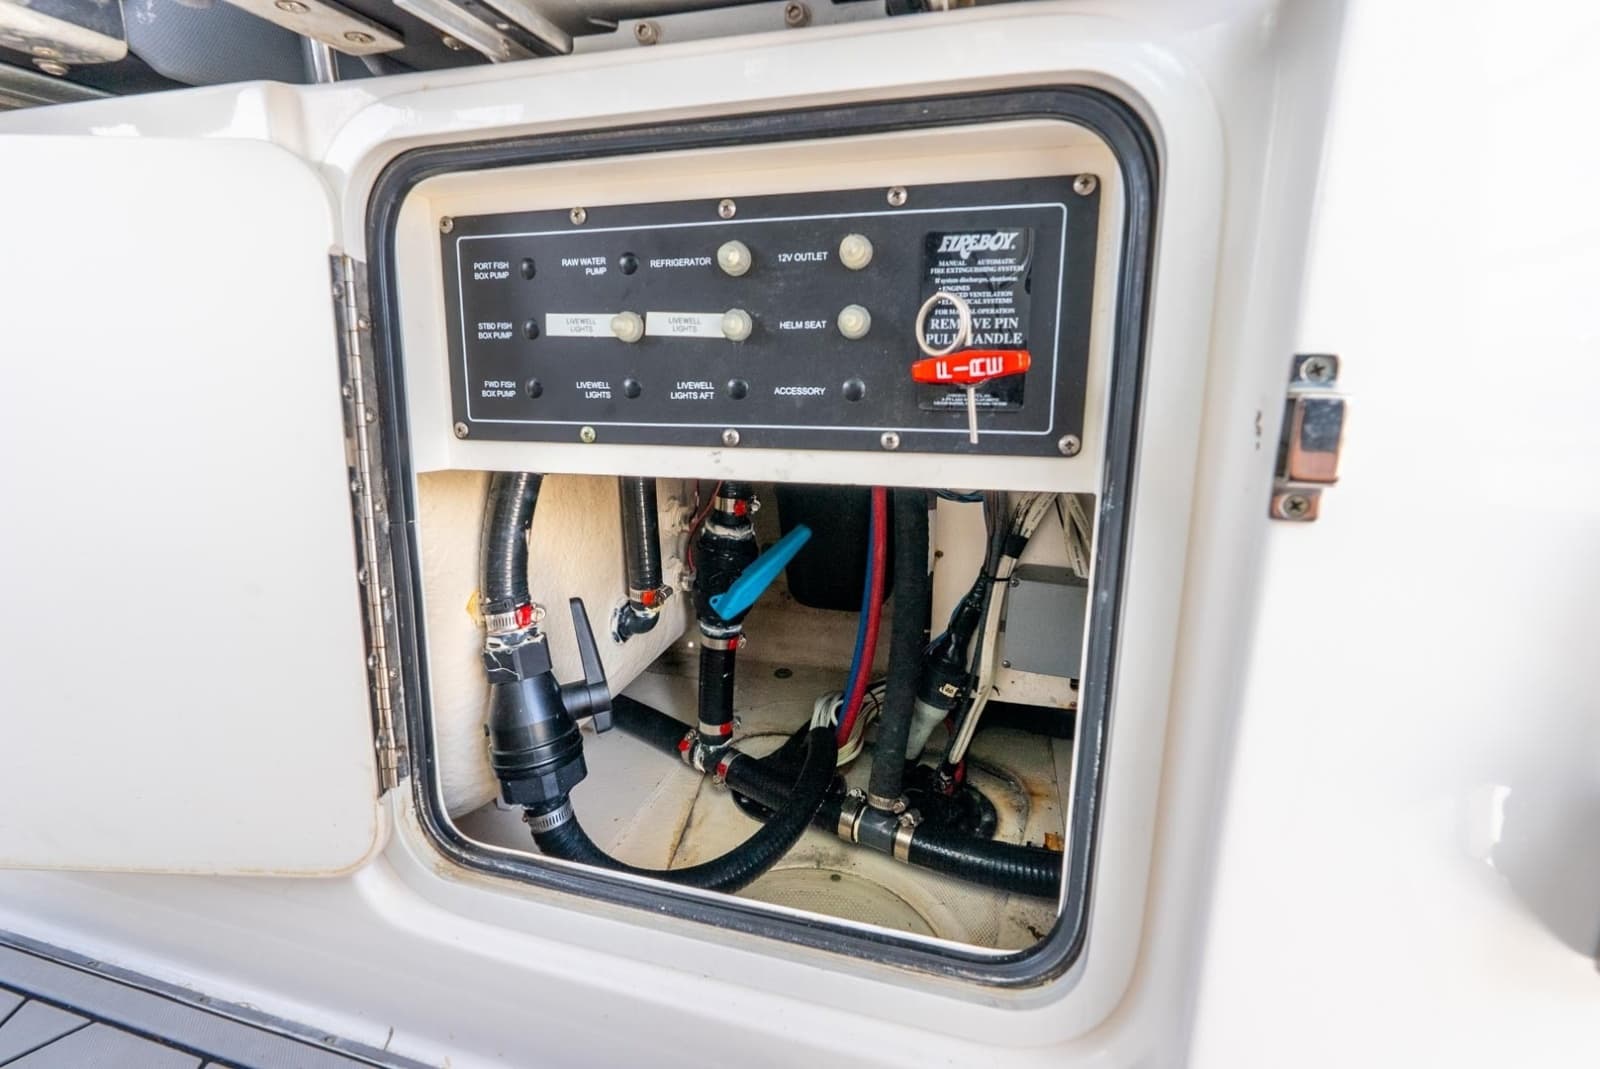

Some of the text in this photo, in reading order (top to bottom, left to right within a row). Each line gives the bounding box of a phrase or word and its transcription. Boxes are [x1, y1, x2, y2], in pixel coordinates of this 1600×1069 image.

[777, 251, 828, 262] 12V OUTLET
[473, 261, 509, 270] PORT FISH
[561, 256, 607, 267] RAW WATER
[650, 257, 712, 268] REFRIGERATOR
[585, 267, 607, 276] PUMP
[998, 264, 1024, 272] SYSTEM
[474, 272, 489, 280] BOX
[668, 317, 701, 325] LIVEWELL
[779, 320, 827, 329] HELM SEAT
[930, 317, 1019, 329] REMVE PIN
[497, 322, 512, 330] FISH
[570, 325, 593, 333] LIGHTS
[672, 325, 697, 333] LIGHTS
[936, 356, 1003, 379] FIRE
[484, 381, 499, 389] FWD
[576, 382, 611, 390] LIVEWELL
[677, 382, 714, 390] LIVEWELL
[481, 390, 495, 398] BOX
[585, 391, 611, 399] LIGHTS
[670, 391, 715, 400] LIGHTS AFT
[774, 387, 826, 396] ACCESSORY
